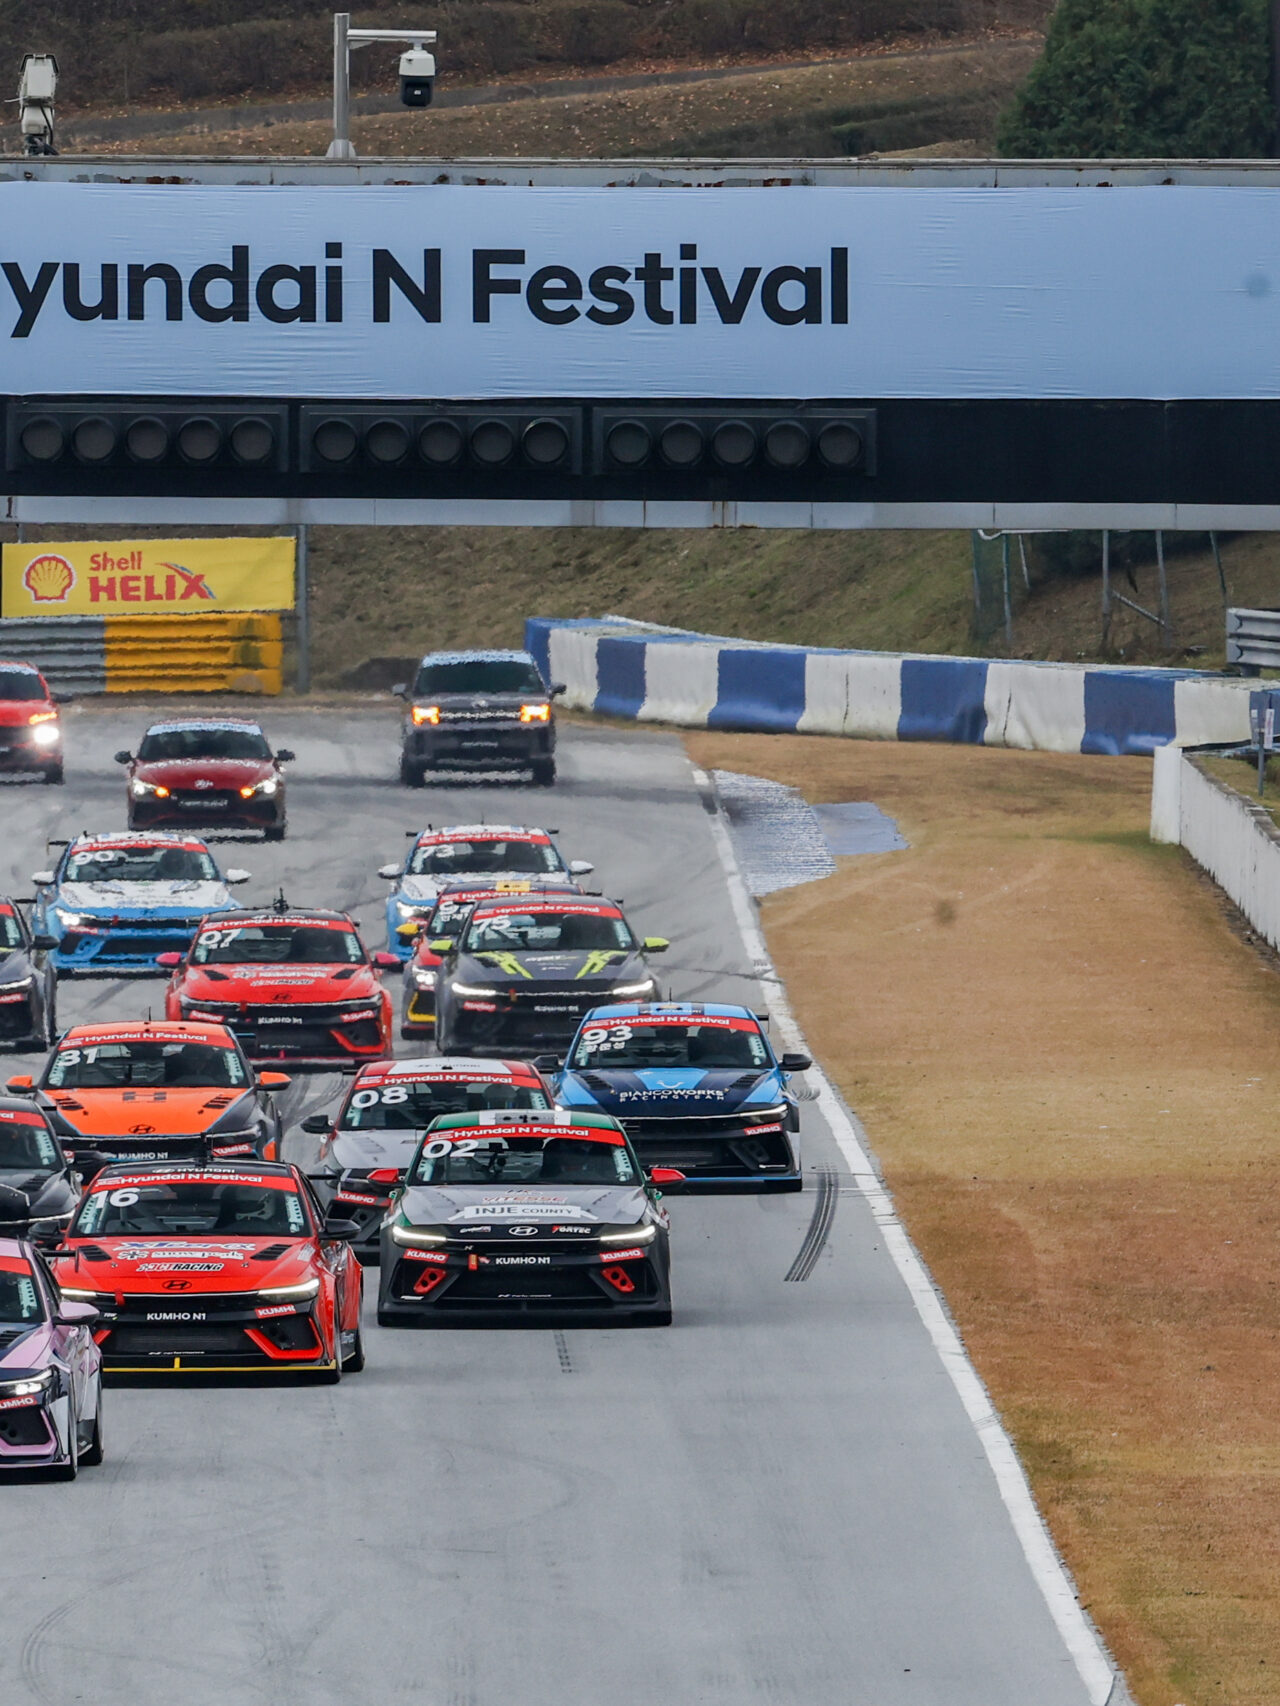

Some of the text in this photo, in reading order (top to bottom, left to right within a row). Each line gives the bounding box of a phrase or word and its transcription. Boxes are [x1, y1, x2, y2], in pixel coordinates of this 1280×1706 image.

[372, 248, 442, 323] N
[472, 243, 849, 326] Festival
[89, 551, 142, 571] Shell
[89, 574, 210, 602] HELIX
[73, 850, 115, 865] 90
[473, 915, 512, 933] 75
[610, 1016, 665, 1025] Hyundai
[680, 1016, 730, 1025] Festival
[85, 1032, 141, 1042] Hyundai
[156, 1032, 207, 1041] Festival
[583, 1025, 634, 1046] 93
[57, 1048, 99, 1066] 31
[384, 1075, 444, 1085] Hyundai
[459, 1075, 513, 1083] Festival
[351, 1086, 409, 1109] 08
[453, 1127, 517, 1137] Hyundai
[533, 1127, 589, 1136] Festival
[422, 1139, 480, 1159] 02
[121, 1173, 186, 1184] Hyundai
[203, 1173, 262, 1183] Festival
[92, 1187, 141, 1209] 16
[406, 1250, 446, 1262] KUMHO
[495, 1257, 534, 1265] KUMHO
[602, 1250, 641, 1261] KUMHO
[147, 1312, 206, 1321] KUMHO N1
[257, 1305, 296, 1317] KUMH
